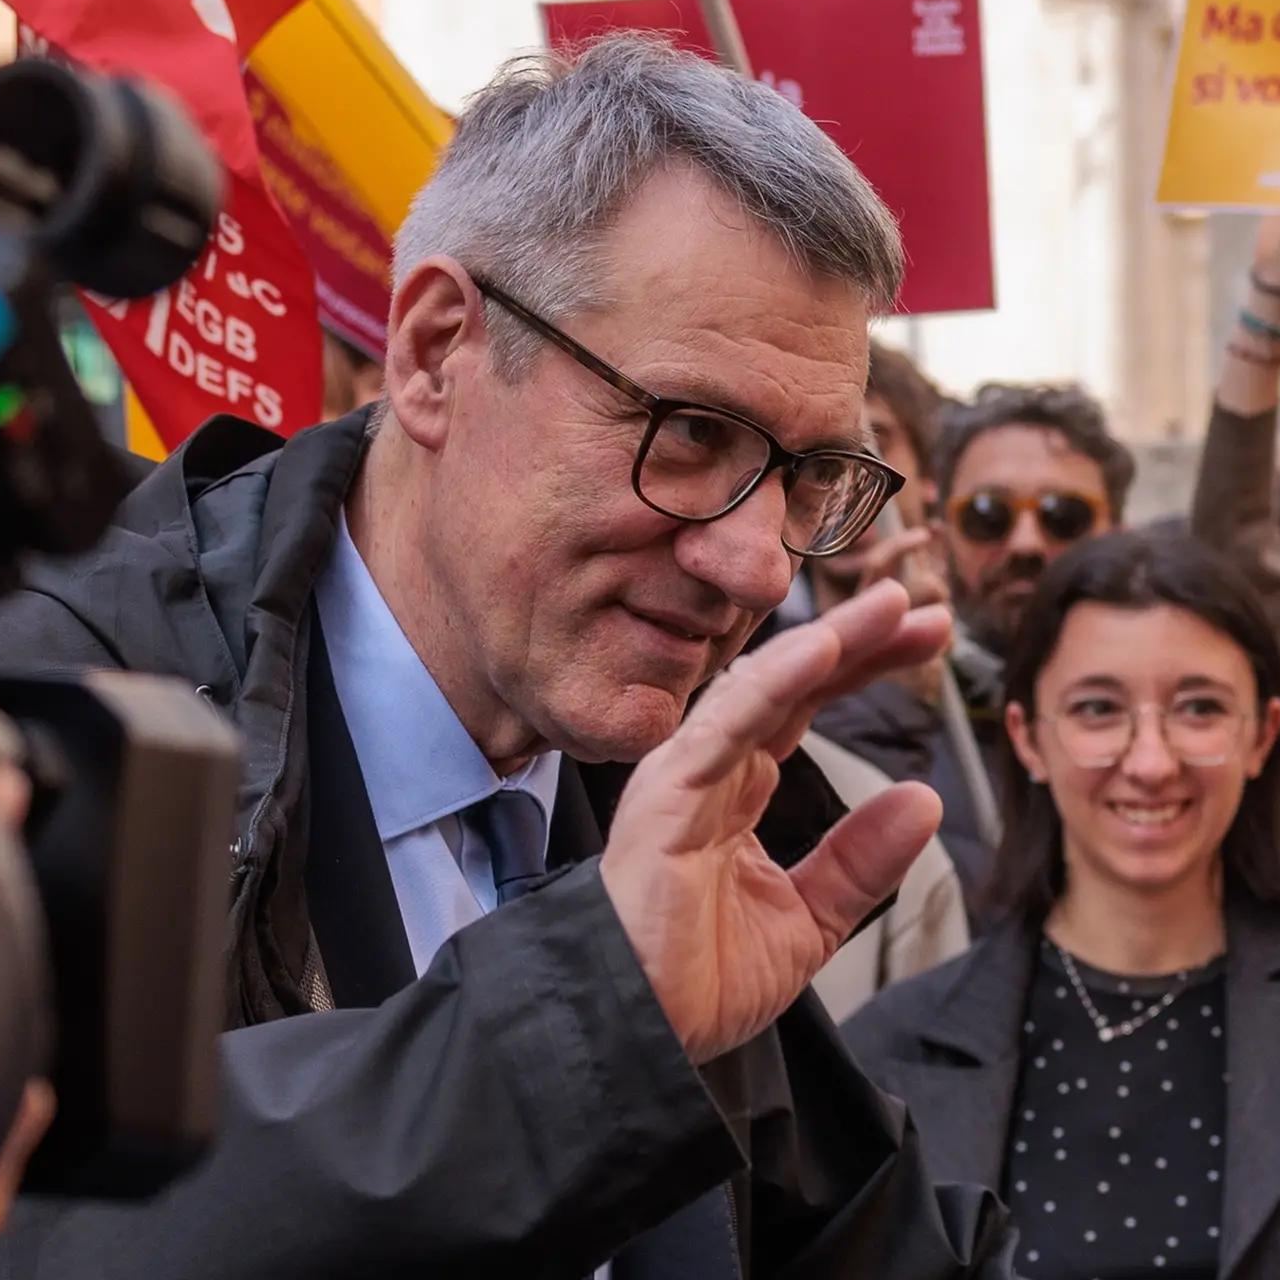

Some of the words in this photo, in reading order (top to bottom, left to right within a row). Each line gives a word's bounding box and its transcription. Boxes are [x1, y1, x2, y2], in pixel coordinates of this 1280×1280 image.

[1202, 3, 1264, 45] Ma
[1192, 60, 1227, 106] si
[168, 330, 284, 428] DEFS
